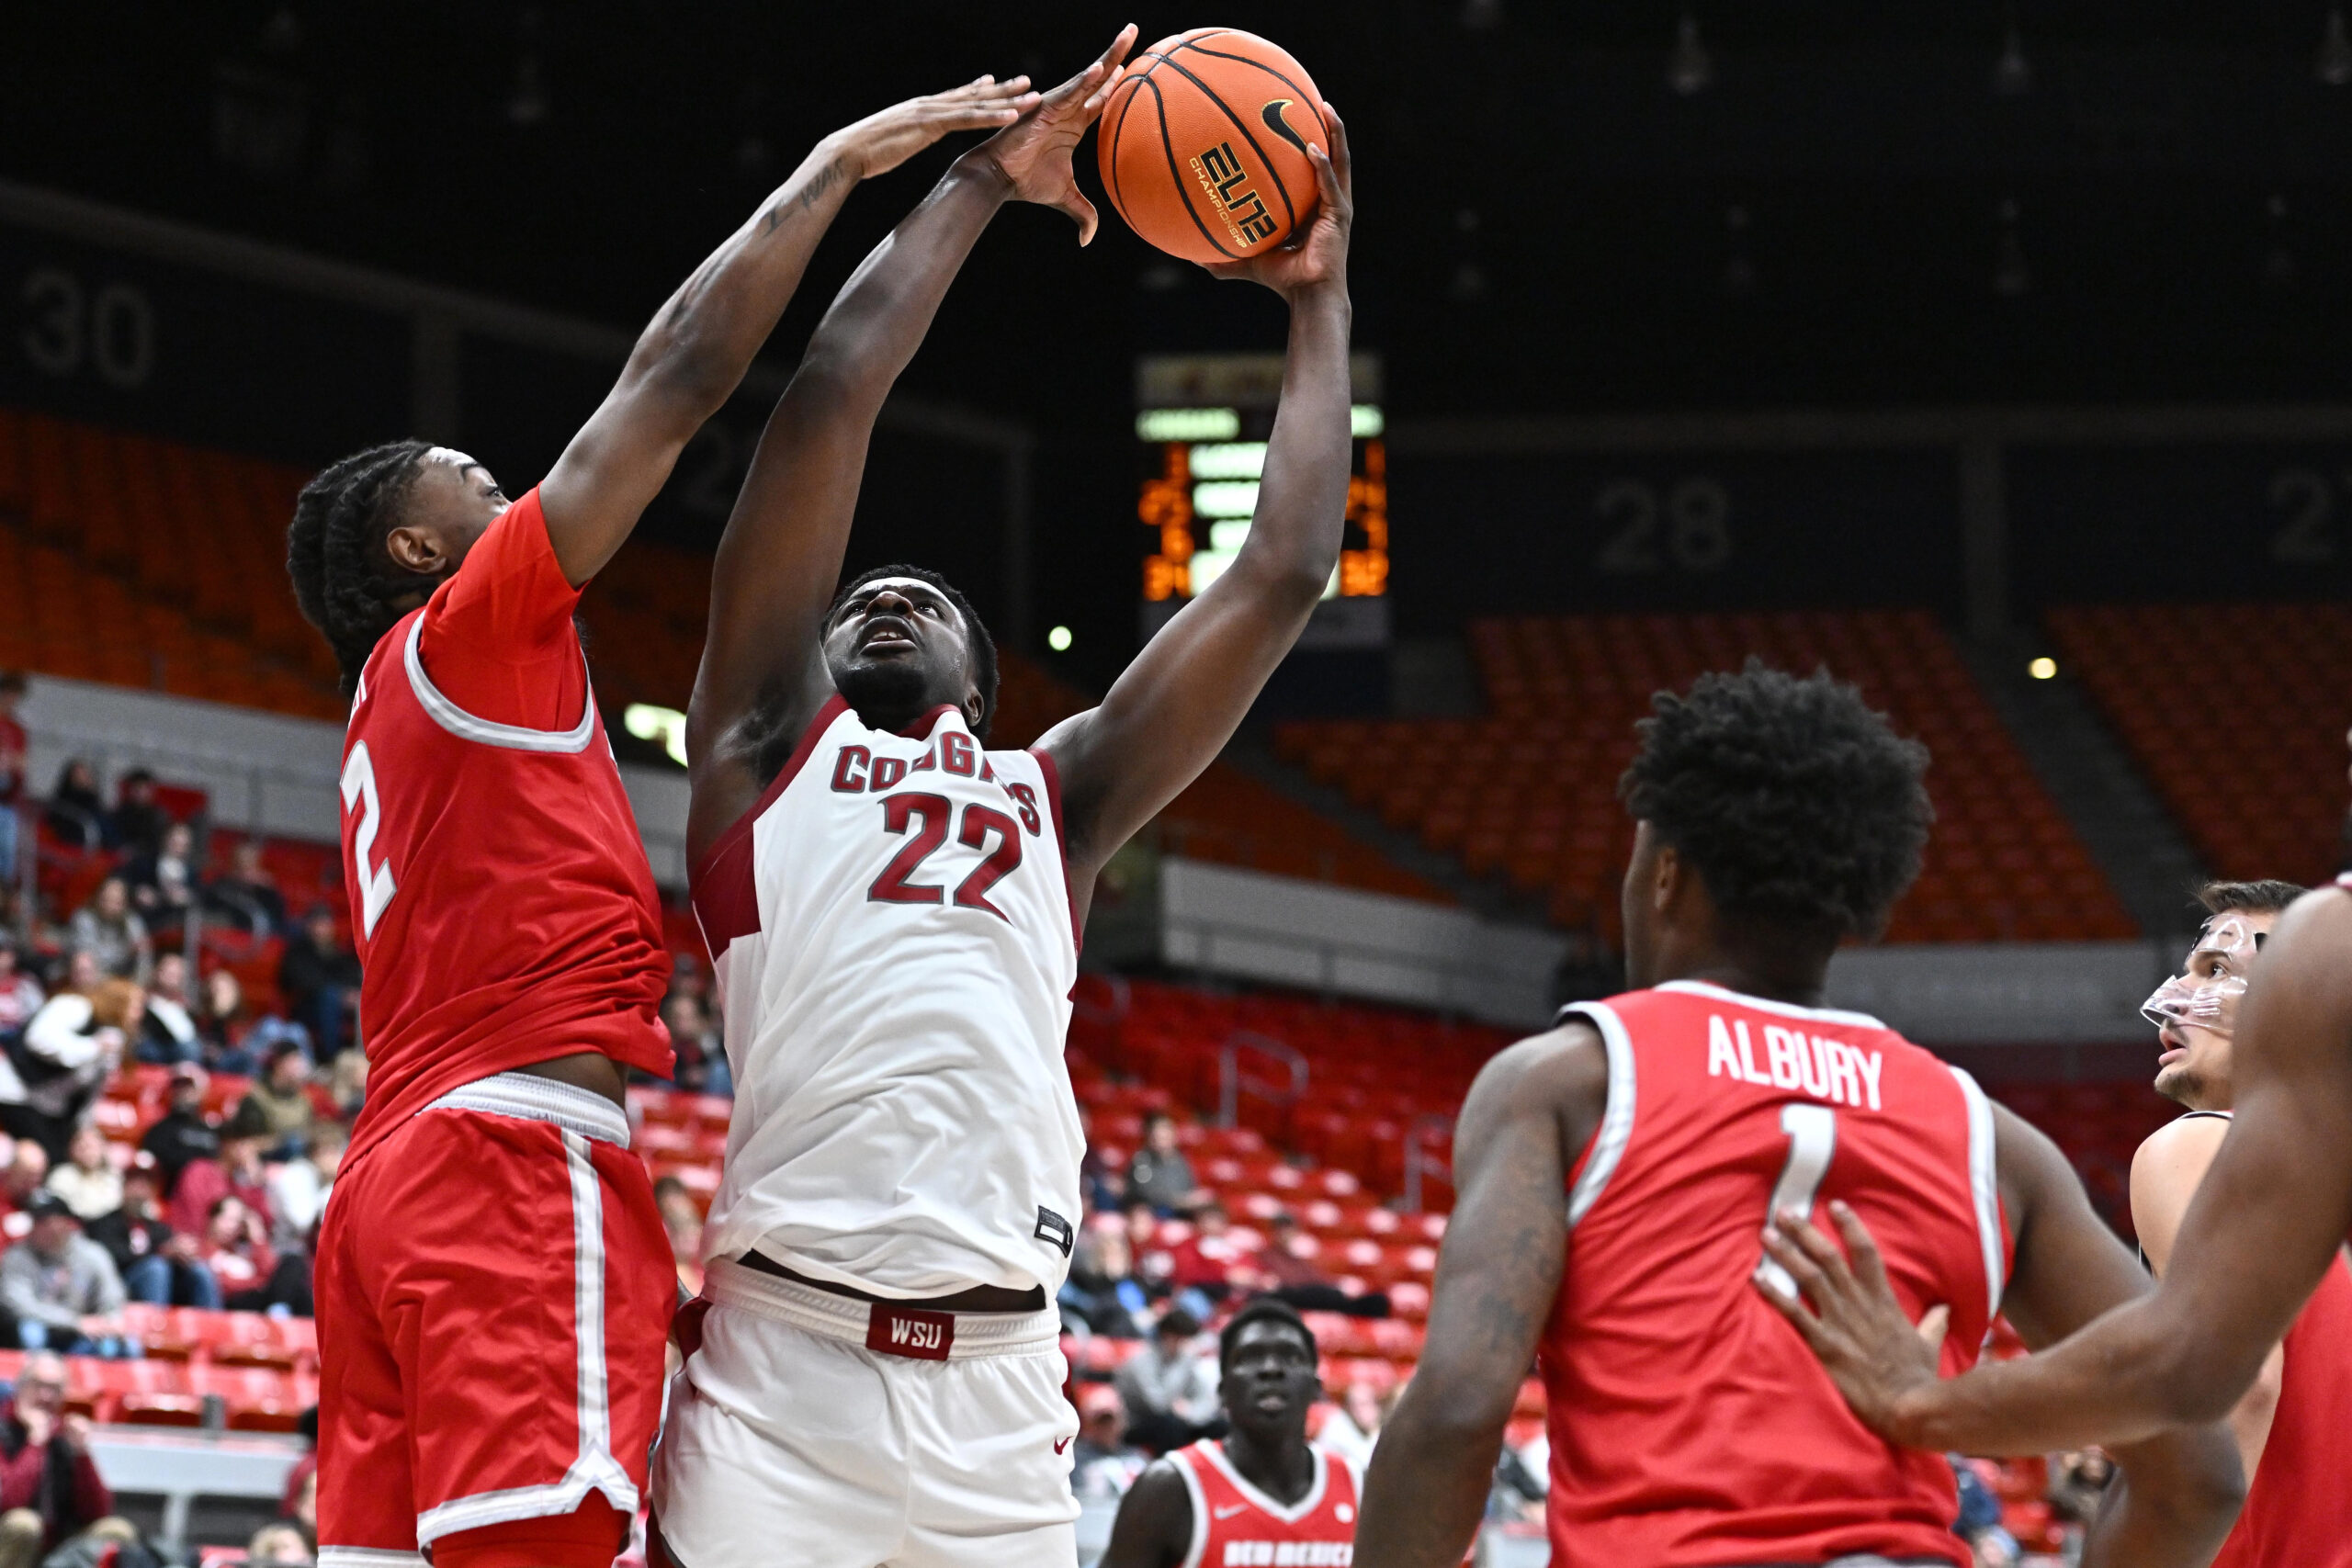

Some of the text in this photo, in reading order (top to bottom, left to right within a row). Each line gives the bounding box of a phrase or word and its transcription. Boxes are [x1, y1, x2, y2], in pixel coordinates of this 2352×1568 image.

[1189, 156, 1248, 249] CHAMPIONSHIP
[1199, 141, 1278, 246] ELITE
[20, 267, 155, 388] 30
[1592, 474, 1732, 574] 28
[2266, 467, 2352, 564] 2
[339, 739, 398, 943] 2
[866, 791, 1023, 926] 22
[1708, 1013, 1883, 1111] ALBURY
[1753, 1102, 1836, 1300] 1
[890, 1317, 943, 1349] WSU
